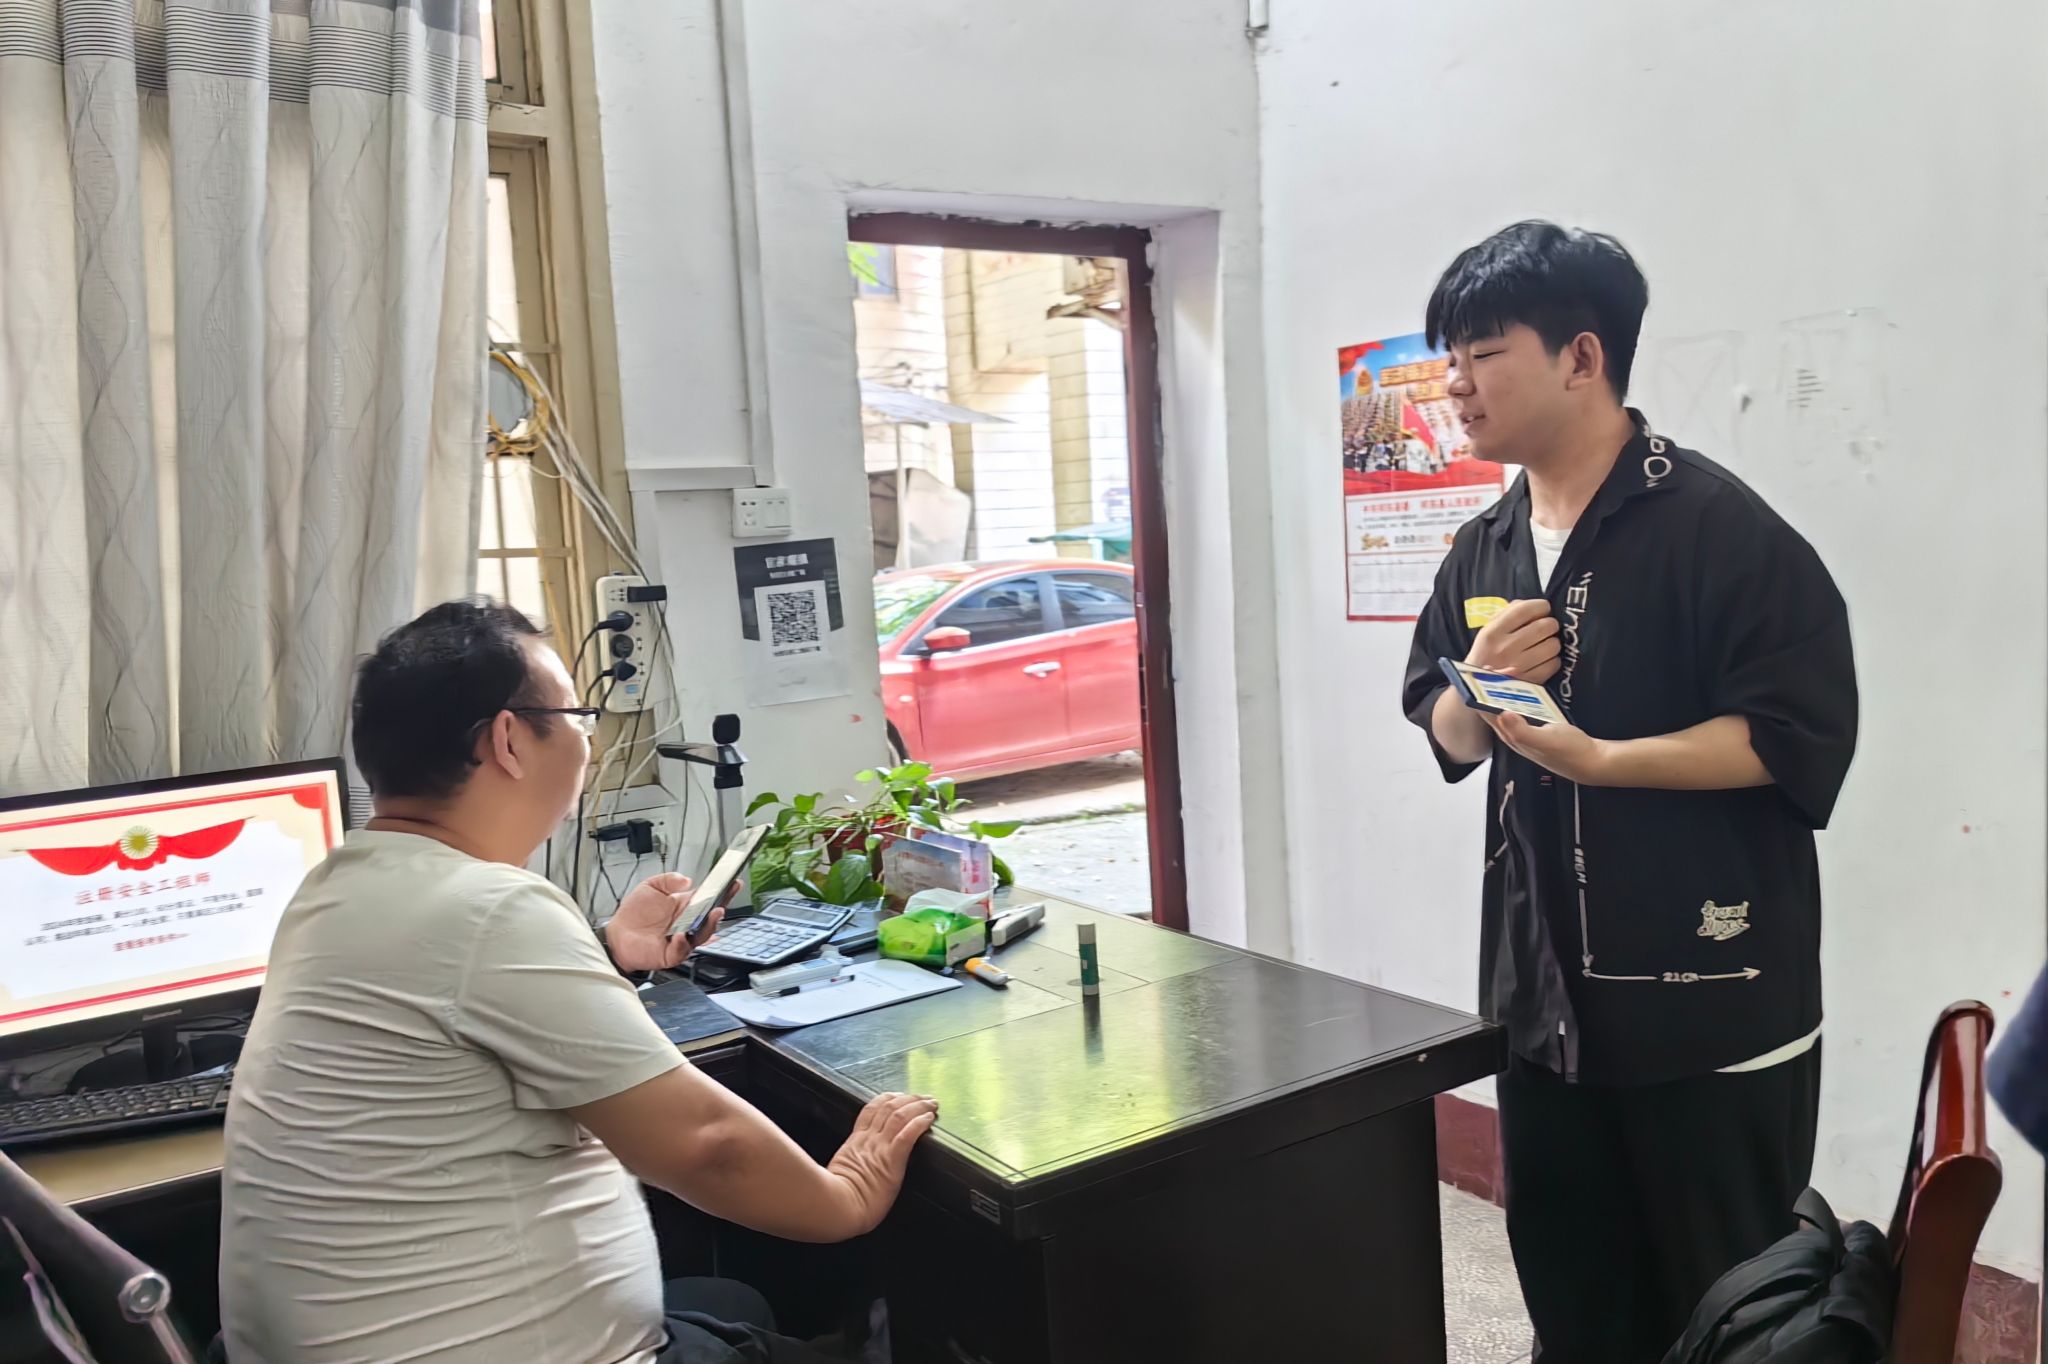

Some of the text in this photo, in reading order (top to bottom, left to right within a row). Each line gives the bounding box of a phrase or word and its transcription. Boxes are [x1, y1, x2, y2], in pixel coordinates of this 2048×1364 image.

[75, 872, 211, 905] 注册安全工程师
